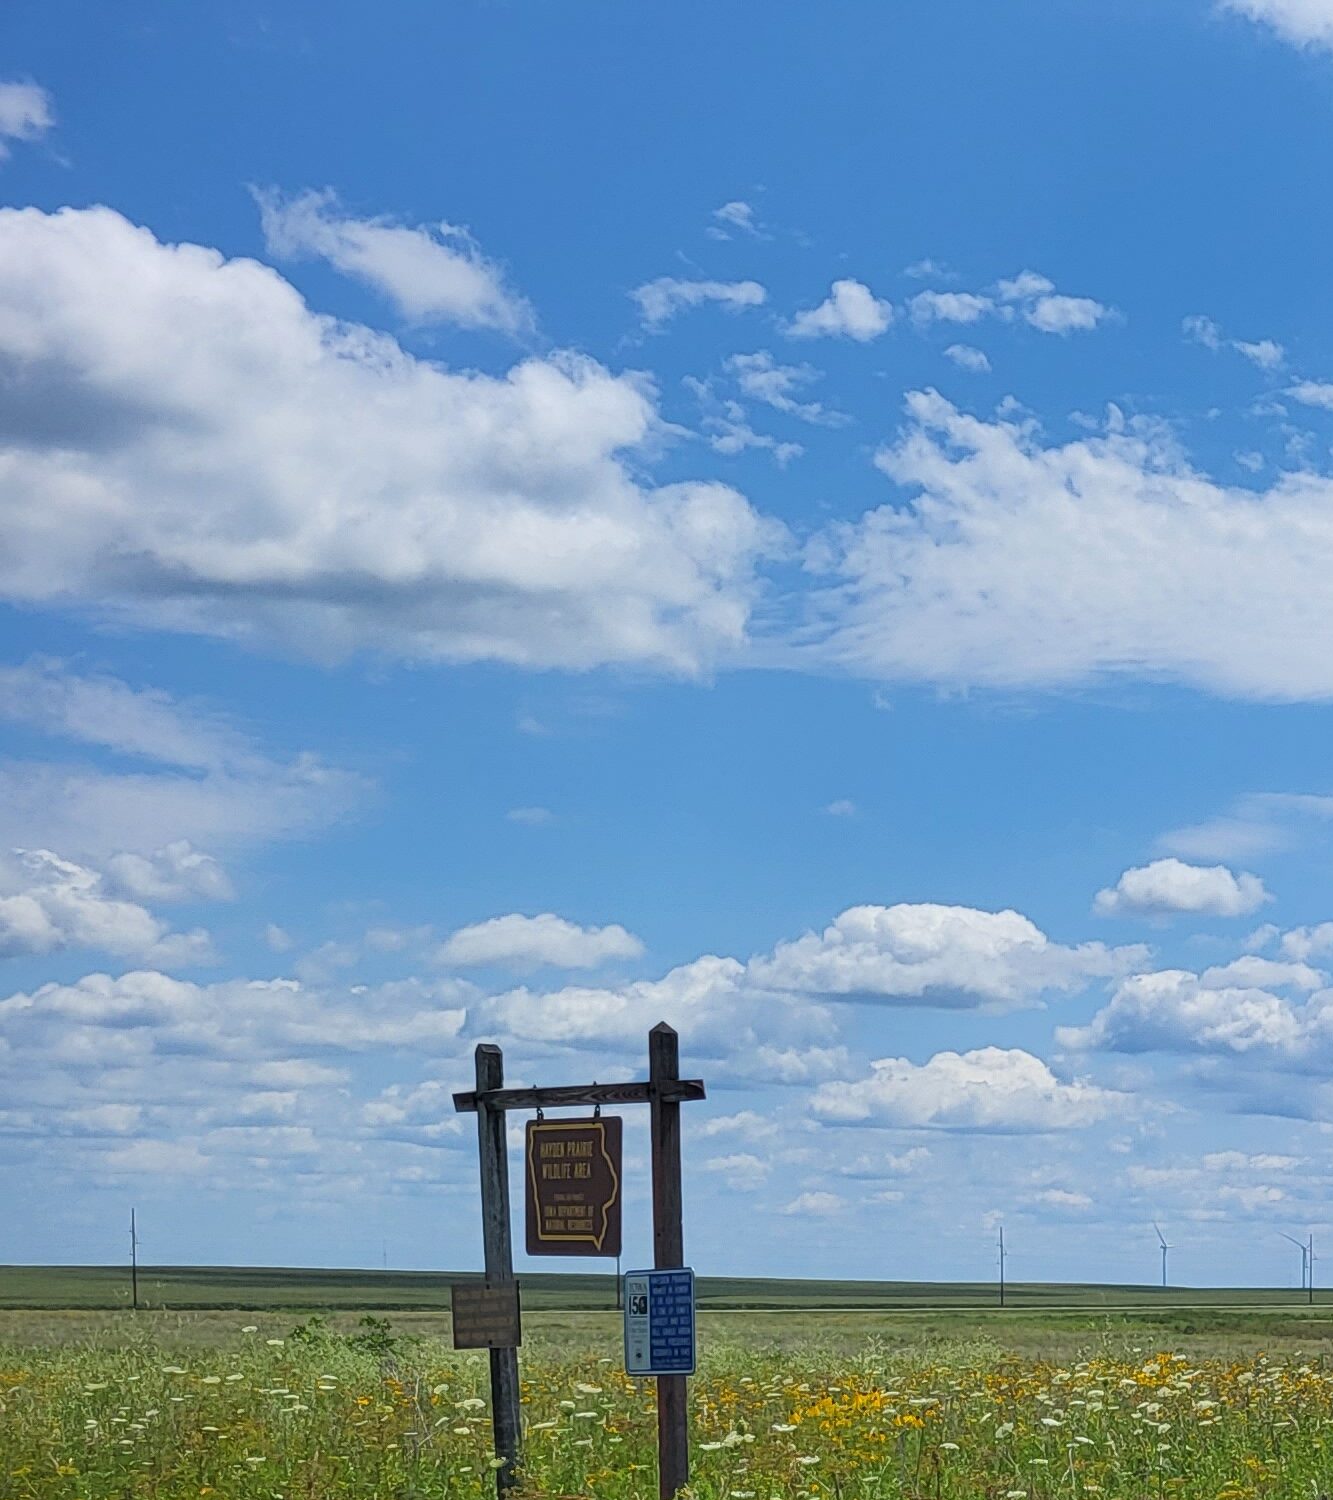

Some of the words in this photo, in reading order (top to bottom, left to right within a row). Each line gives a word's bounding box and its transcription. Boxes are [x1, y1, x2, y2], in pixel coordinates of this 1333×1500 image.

[540, 1142, 564, 1158] HAYDEN
[567, 1141, 593, 1157] PRAIRIE
[542, 1163, 571, 1179] WILDLIFE
[574, 1162, 592, 1178] AREA
